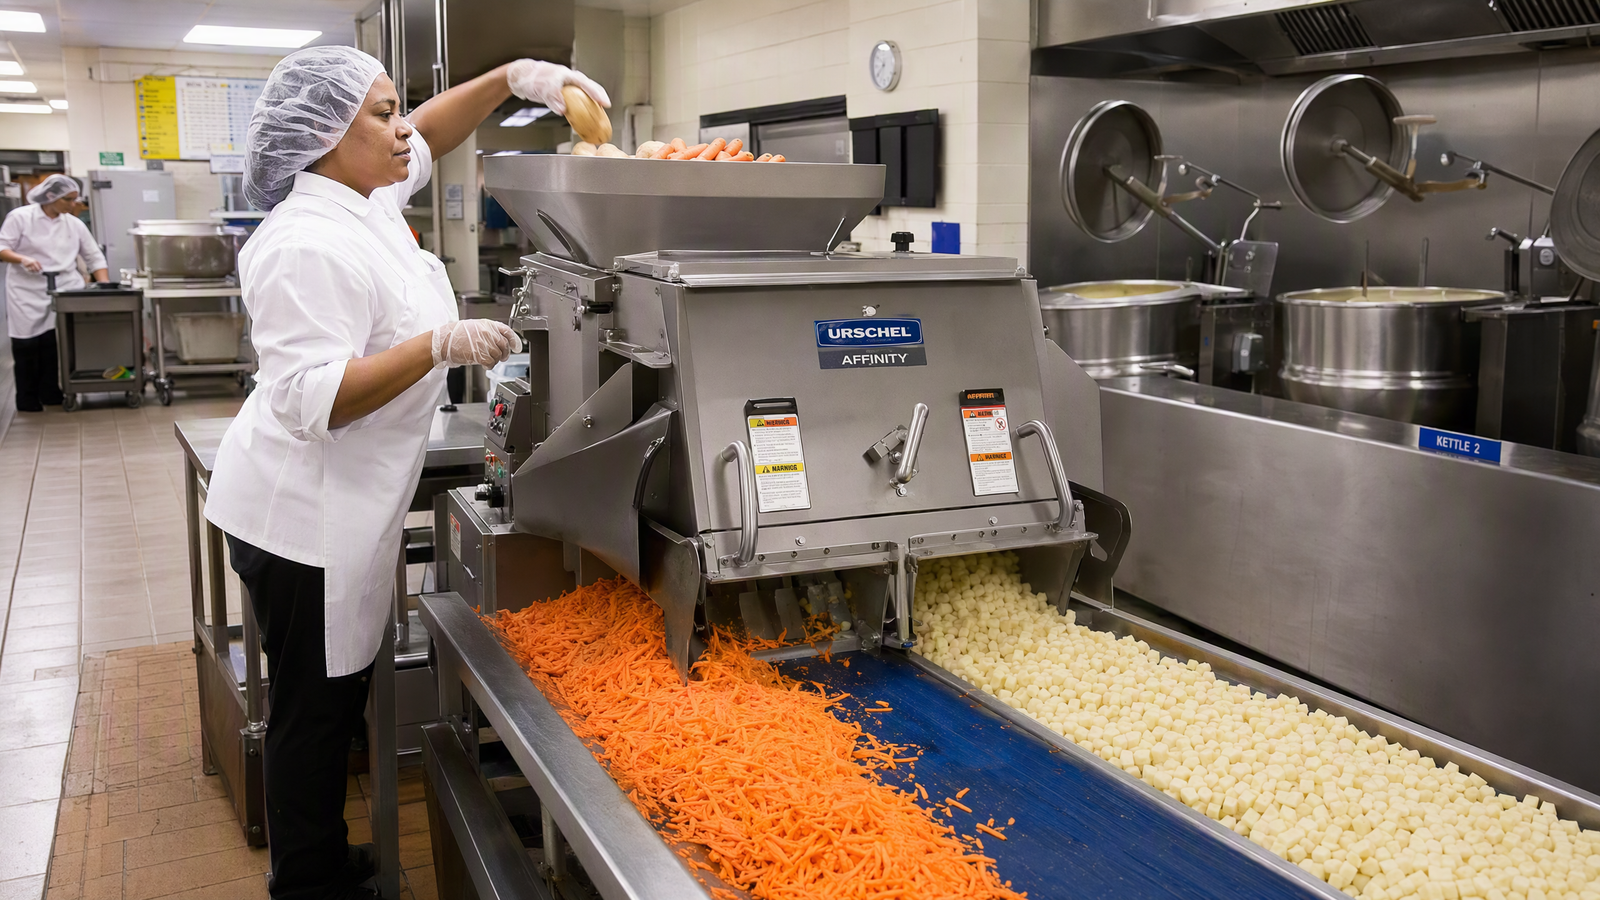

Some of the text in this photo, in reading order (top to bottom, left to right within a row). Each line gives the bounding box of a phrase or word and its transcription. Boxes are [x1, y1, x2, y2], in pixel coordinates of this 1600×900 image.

[827, 326, 912, 339] URSCHEL
[841, 353, 909, 365] AFFINITY
[1436, 435, 1481, 455] KETTLE 2
